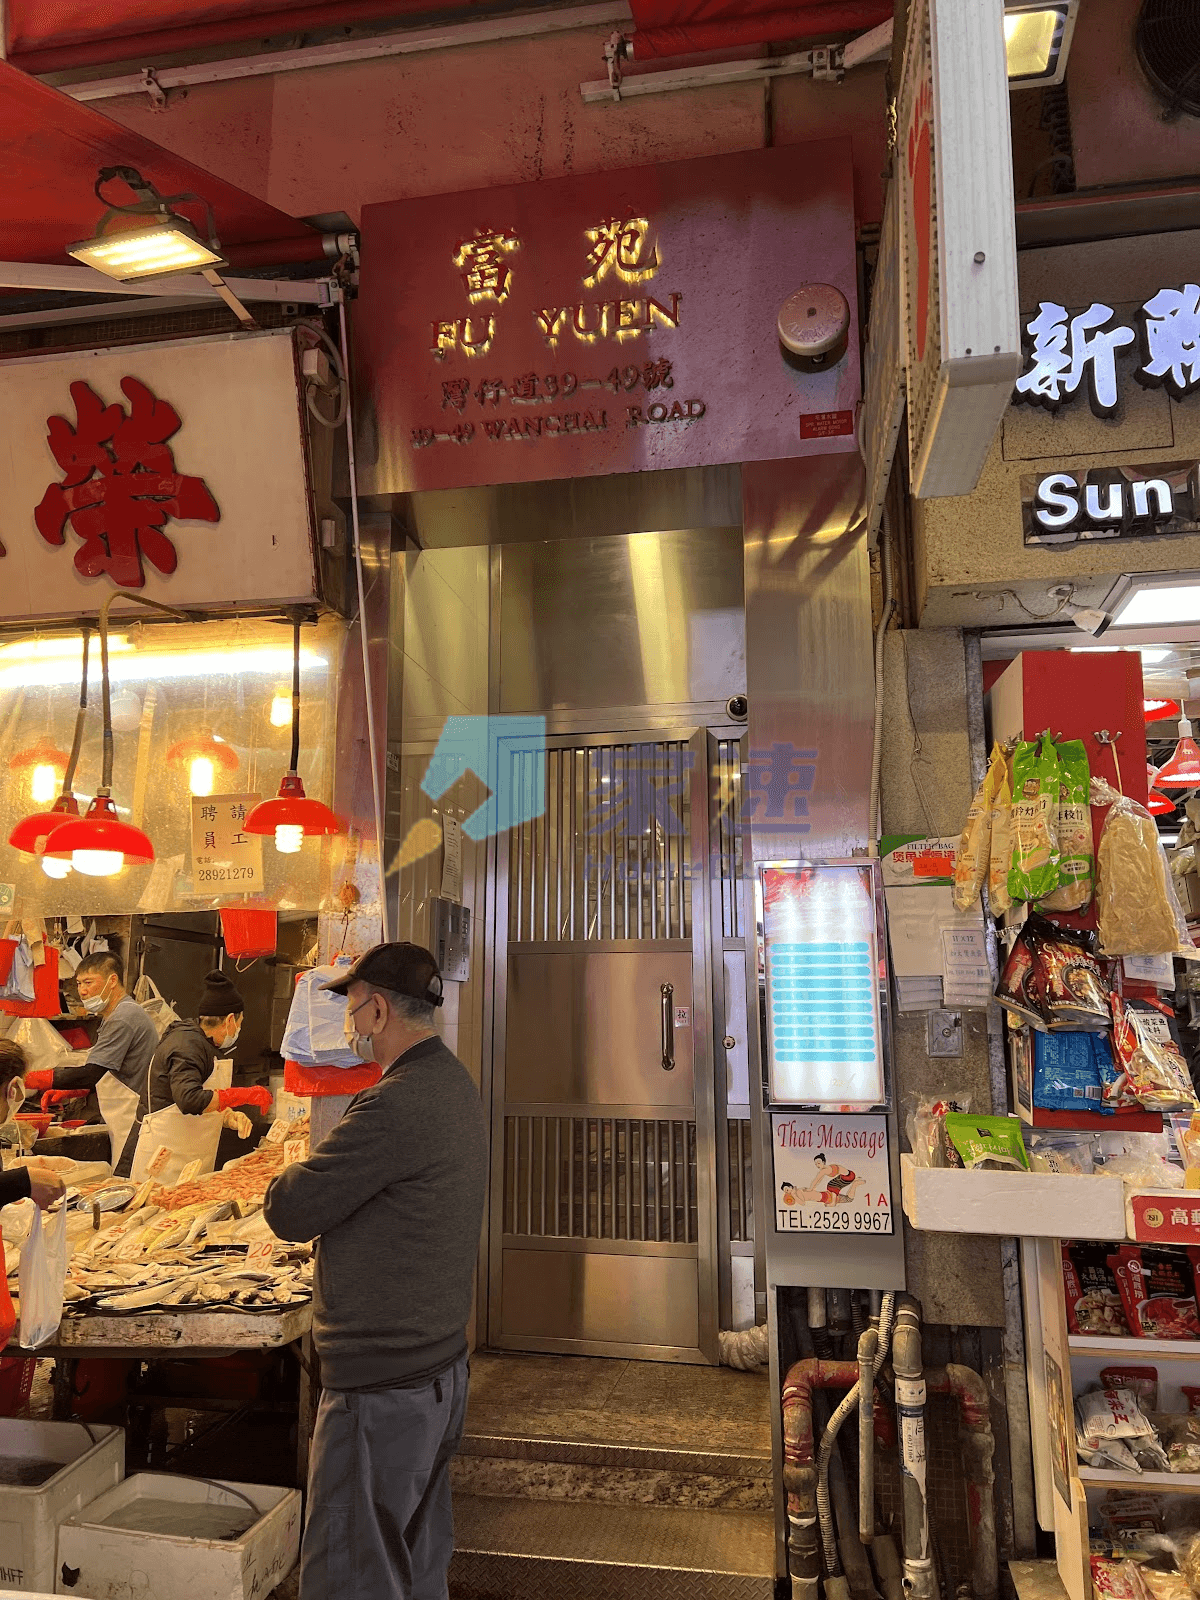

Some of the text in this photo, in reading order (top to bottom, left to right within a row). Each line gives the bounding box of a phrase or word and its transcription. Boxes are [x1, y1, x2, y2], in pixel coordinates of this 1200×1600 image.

[429, 293, 682, 358] FU YUEN
[481, 410, 607, 441] WANCHAI
[626, 400, 706, 428] ROAD
[1036, 474, 1173, 526] Sun
[200, 804, 247, 822] 聘請
[204, 831, 248, 849] 員工
[938, 842, 954, 850] BAG
[198, 867, 255, 881] 28921279
[777, 1120, 885, 1158] Thai Massage
[778, 1210, 890, 1230] TEL:2529 9967
[249, 1242, 273, 1259] 20
